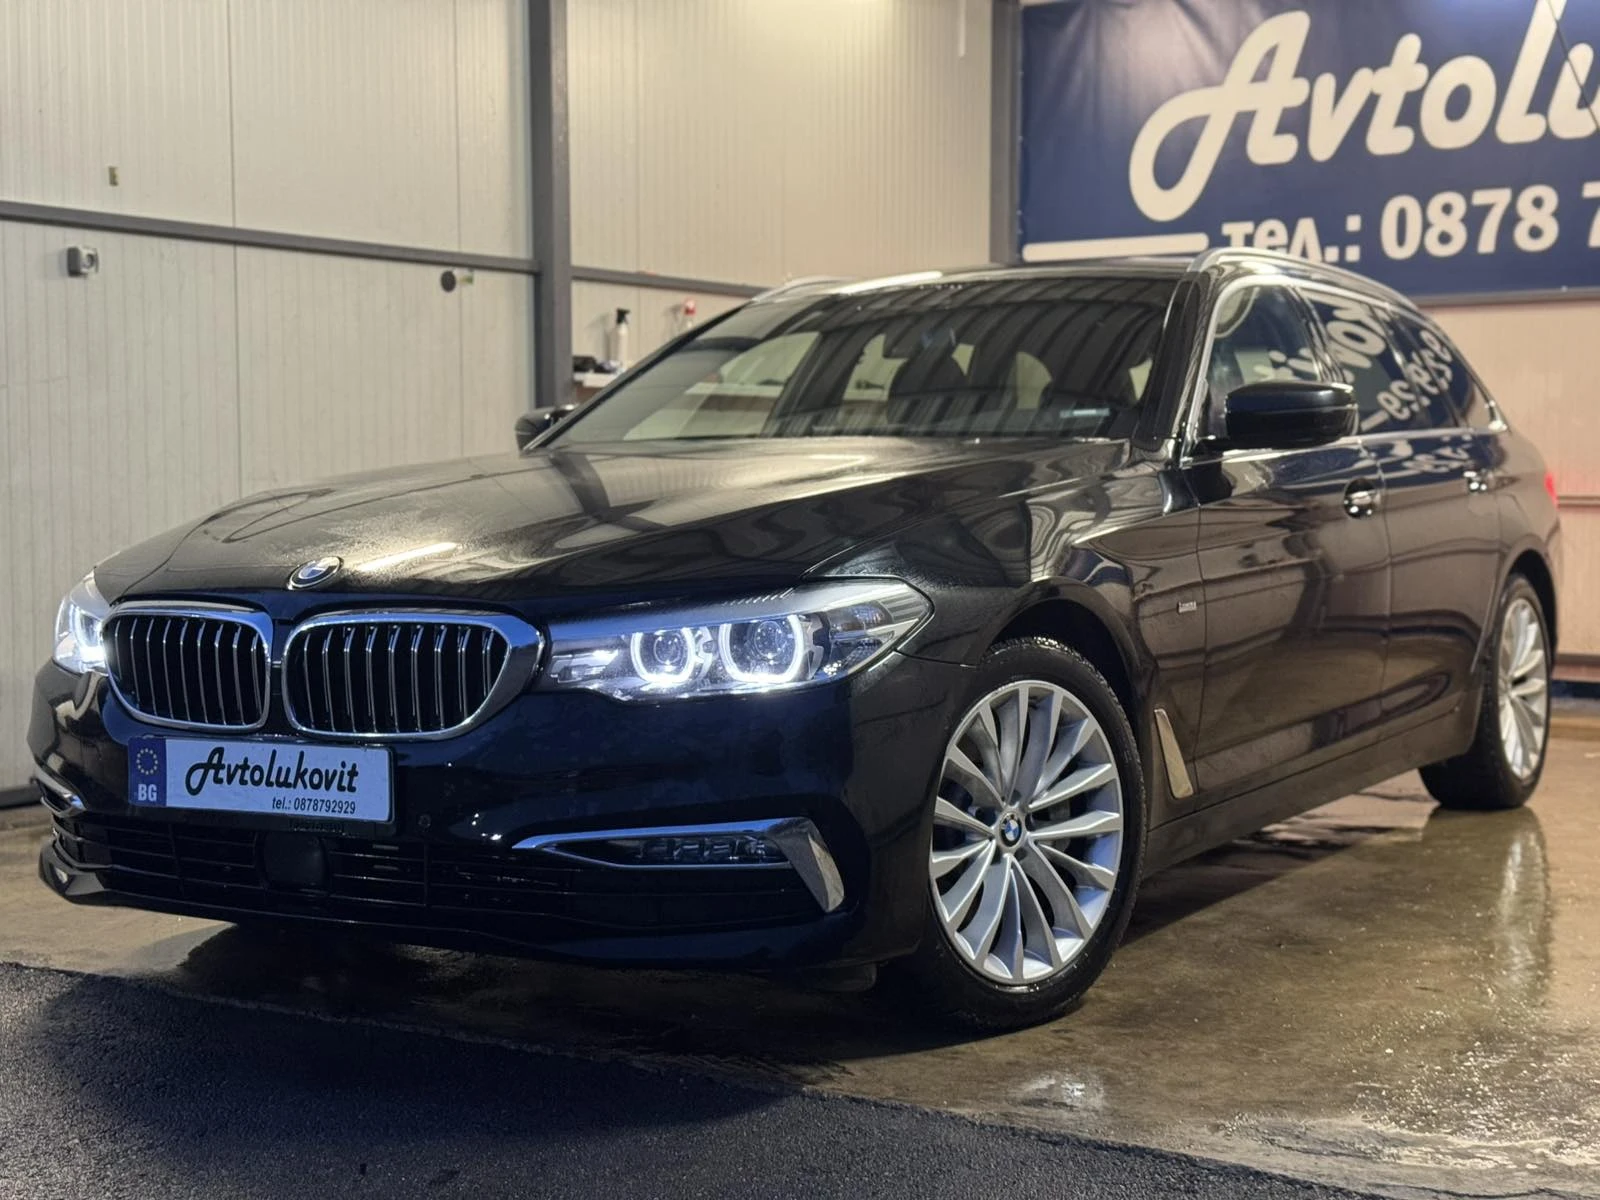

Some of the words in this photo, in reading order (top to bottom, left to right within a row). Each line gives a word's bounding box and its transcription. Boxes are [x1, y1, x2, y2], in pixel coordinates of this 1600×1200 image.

[1380, 184, 1560, 260] 0878
[185, 746, 358, 796] Avtolukovit
[137, 782, 158, 802] BG
[272, 796, 292, 810] tel.:
[293, 797, 356, 815] 0878792929
